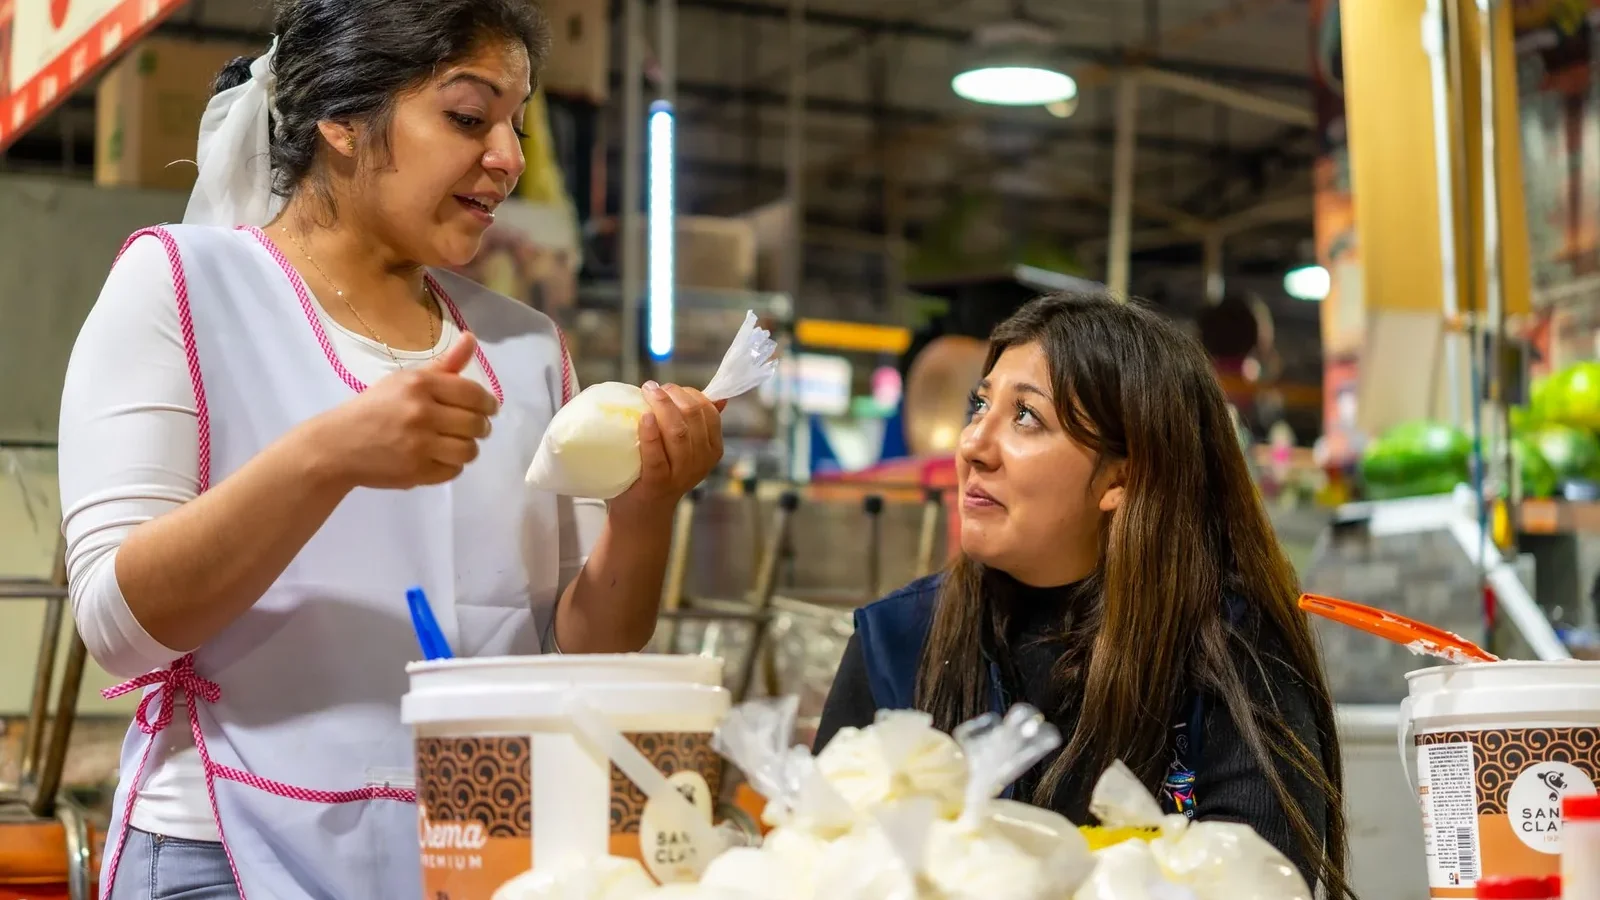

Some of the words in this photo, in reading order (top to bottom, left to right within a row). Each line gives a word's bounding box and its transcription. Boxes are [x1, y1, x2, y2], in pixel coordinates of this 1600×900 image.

[1522, 807, 1560, 819] SAN
[1522, 821, 1567, 832] CLA
[656, 831, 690, 846] SAN
[655, 847, 697, 864] CLA
